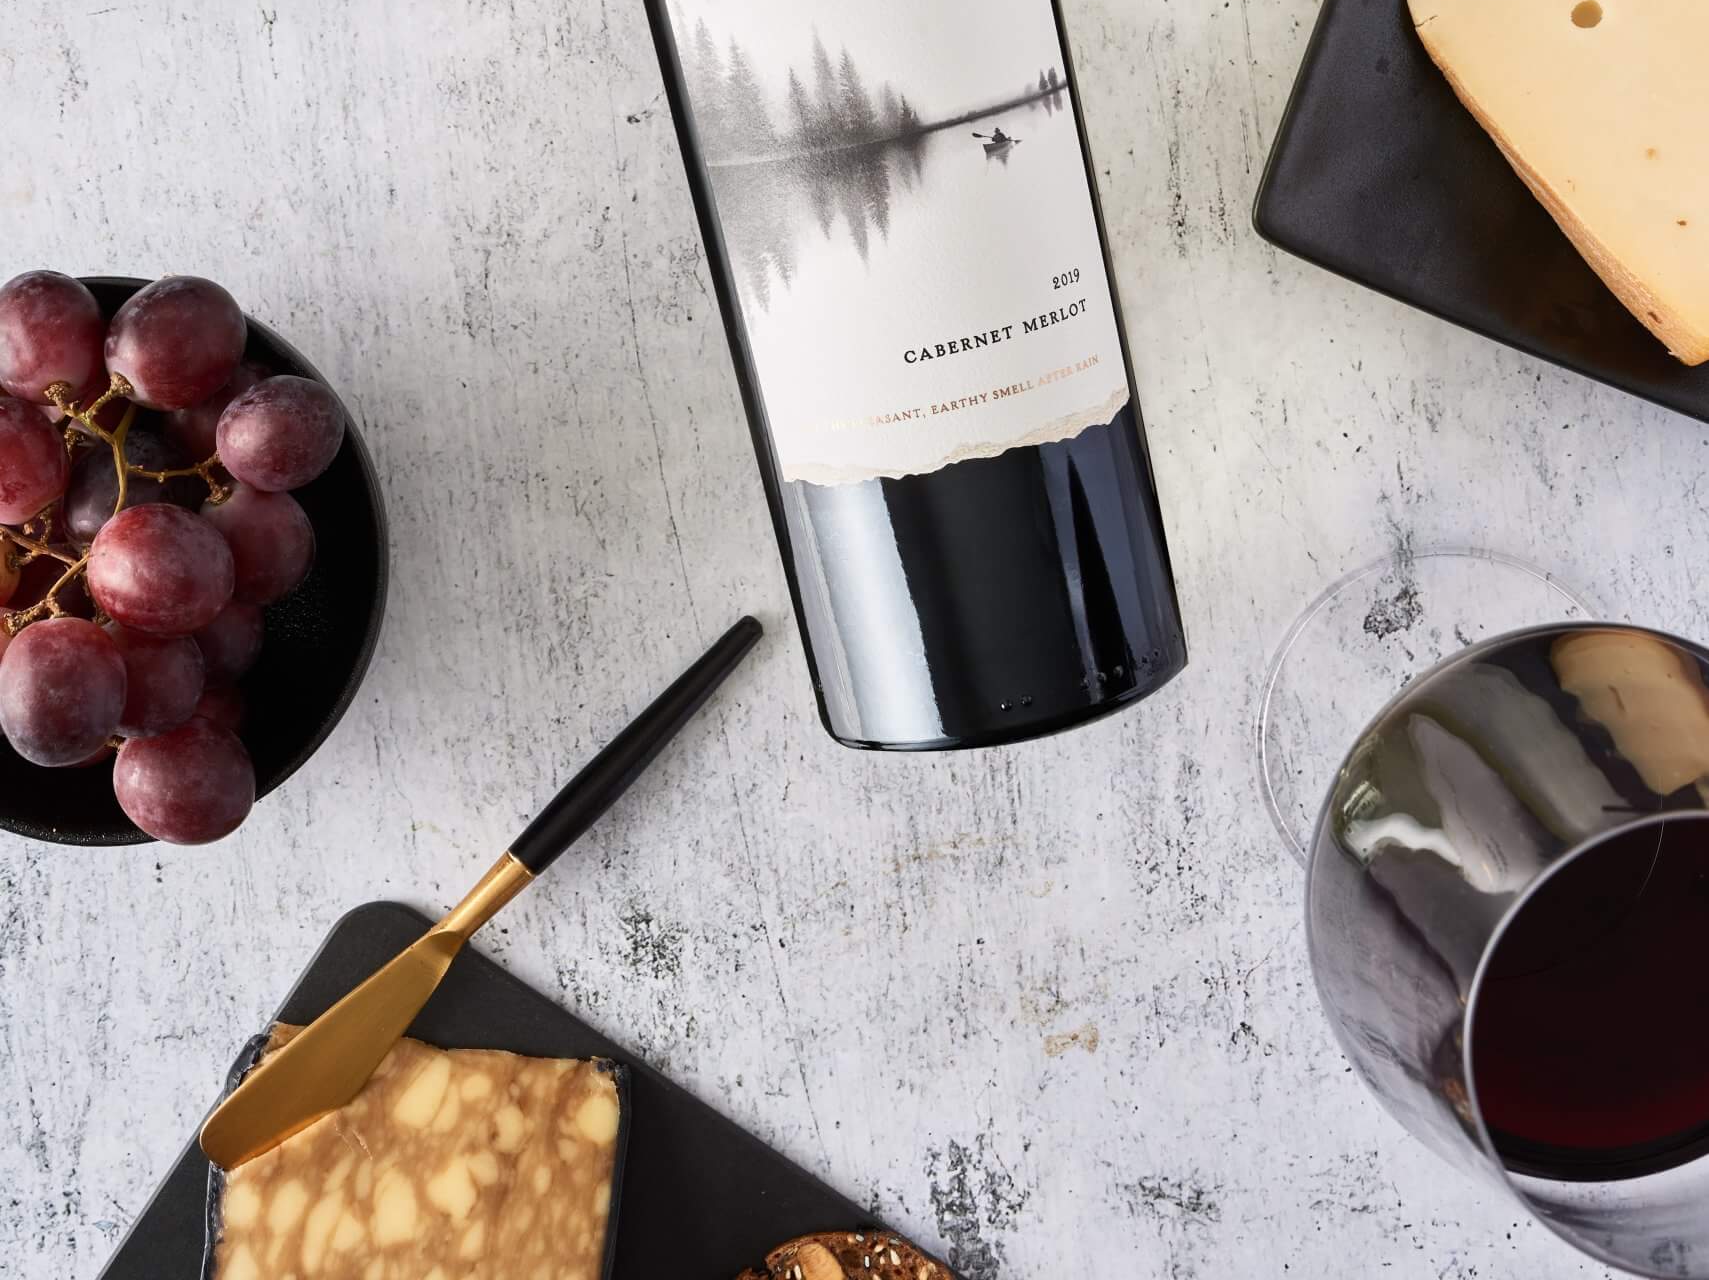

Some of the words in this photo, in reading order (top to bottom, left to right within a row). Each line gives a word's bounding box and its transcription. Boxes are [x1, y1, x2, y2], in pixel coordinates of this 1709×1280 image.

[1052, 268, 1080, 290] 2019
[903, 326, 1013, 365] CABERNET
[1022, 299, 1087, 335] MERLOT
[930, 391, 987, 416] EARTHY
[992, 380, 1035, 401] SMELL
